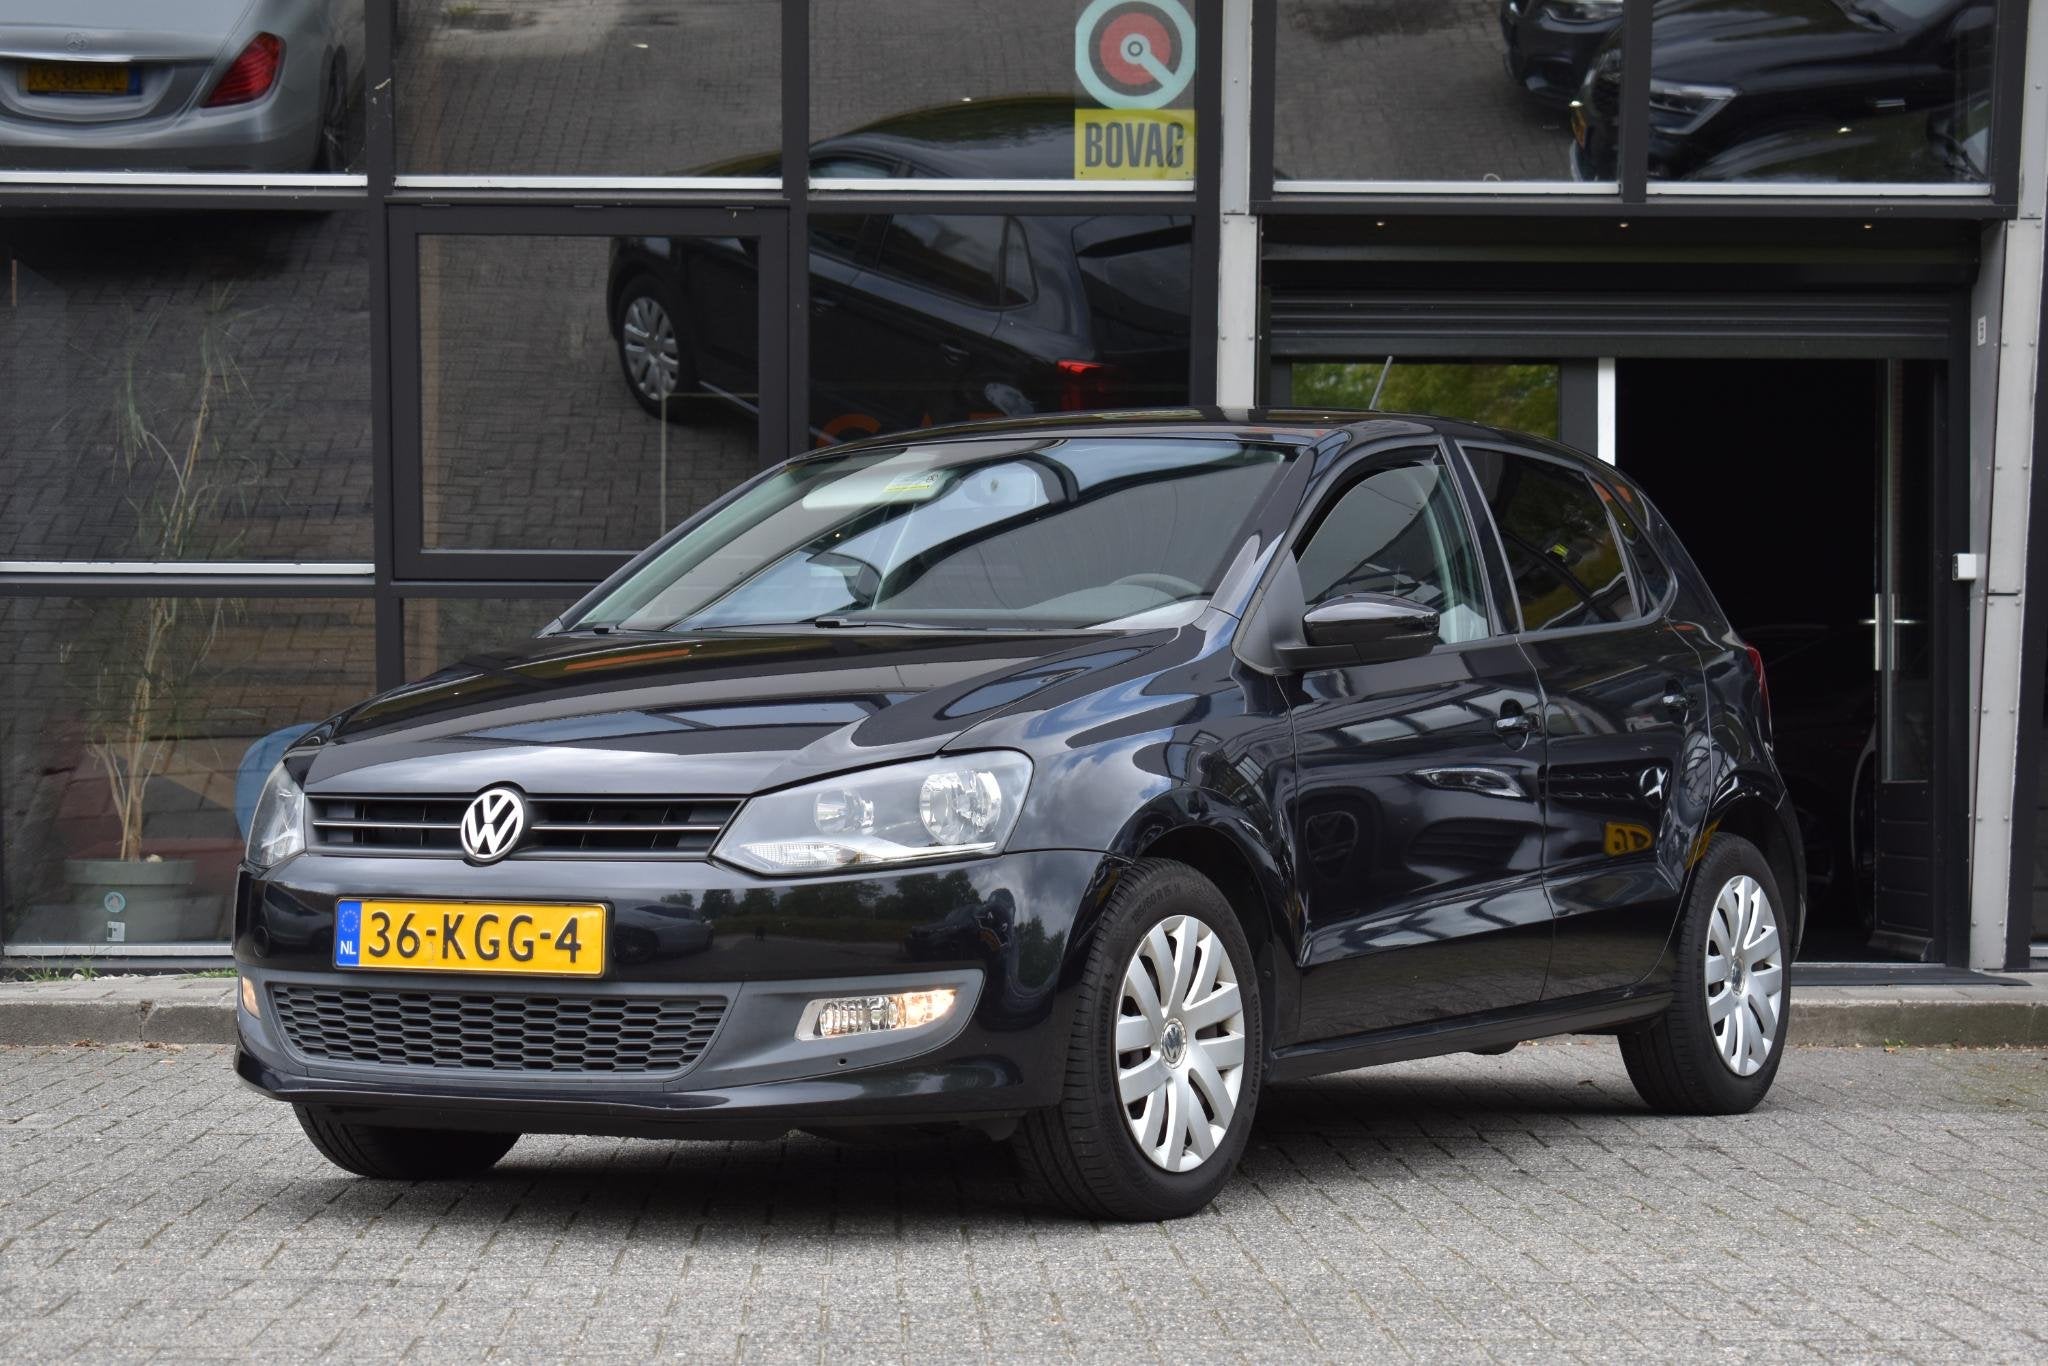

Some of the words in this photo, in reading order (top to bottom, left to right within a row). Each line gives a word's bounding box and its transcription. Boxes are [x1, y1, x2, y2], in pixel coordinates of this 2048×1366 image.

[1085, 122, 1184, 168] BOVAG
[340, 940, 357, 955] NL
[368, 911, 582, 963] 36-KGG-4
